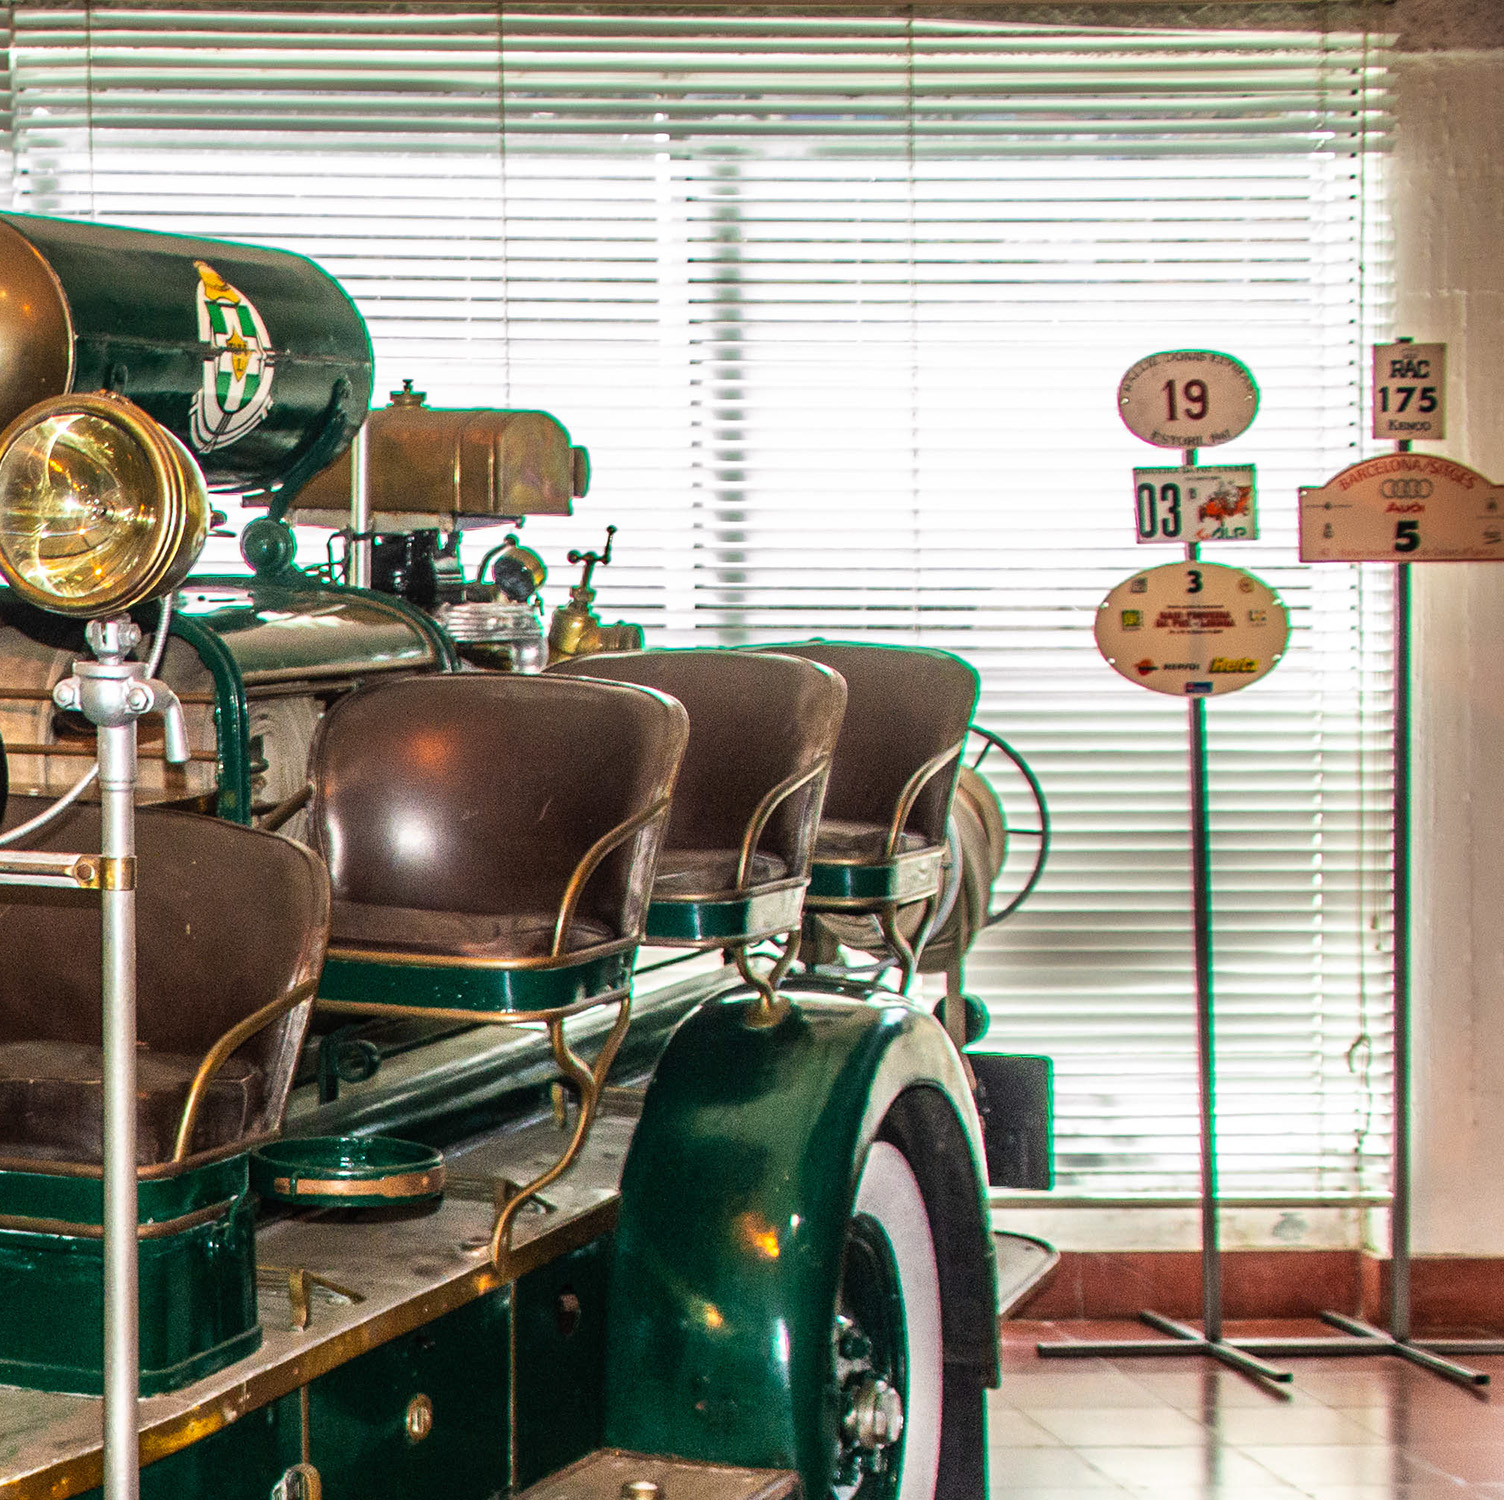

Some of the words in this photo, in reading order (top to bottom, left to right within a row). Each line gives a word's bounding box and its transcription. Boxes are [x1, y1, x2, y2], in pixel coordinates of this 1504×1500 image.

[1389, 359, 1431, 378] RAC
[1162, 378, 1209, 422] 19
[1378, 385, 1439, 413] 175
[1137, 482, 1182, 538] 03
[1394, 519, 1421, 552] 5
[1186, 569, 1203, 593] 3
